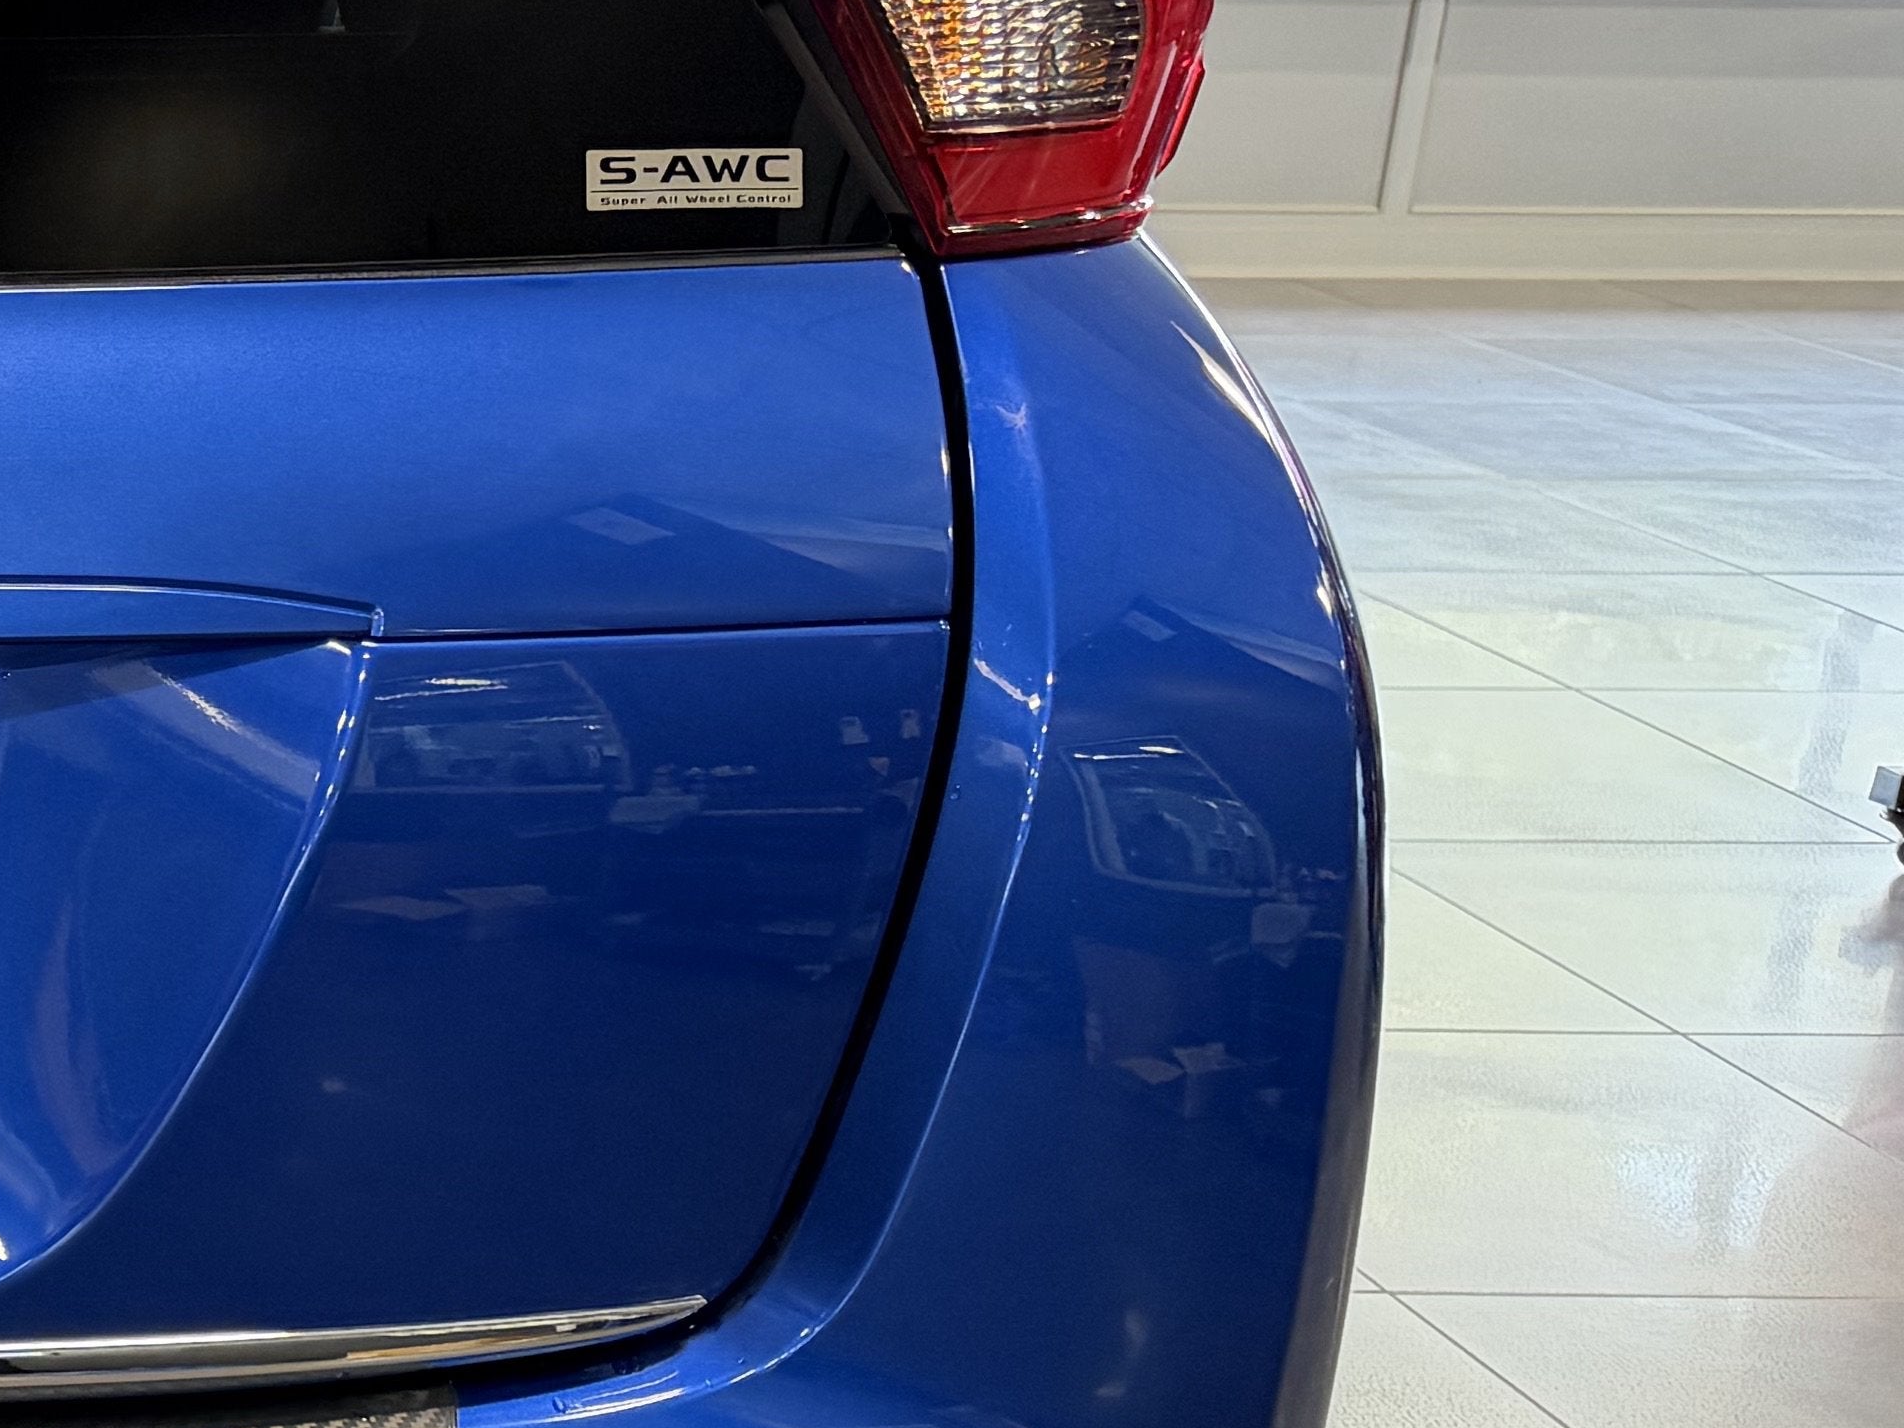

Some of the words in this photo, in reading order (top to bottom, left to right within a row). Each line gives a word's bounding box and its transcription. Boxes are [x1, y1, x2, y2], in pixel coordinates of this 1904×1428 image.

[599, 155, 790, 185] S-AWC
[600, 196, 646, 207] Super
[657, 196, 678, 205] All
[686, 194, 730, 204] Wheel
[736, 194, 792, 204] Control
